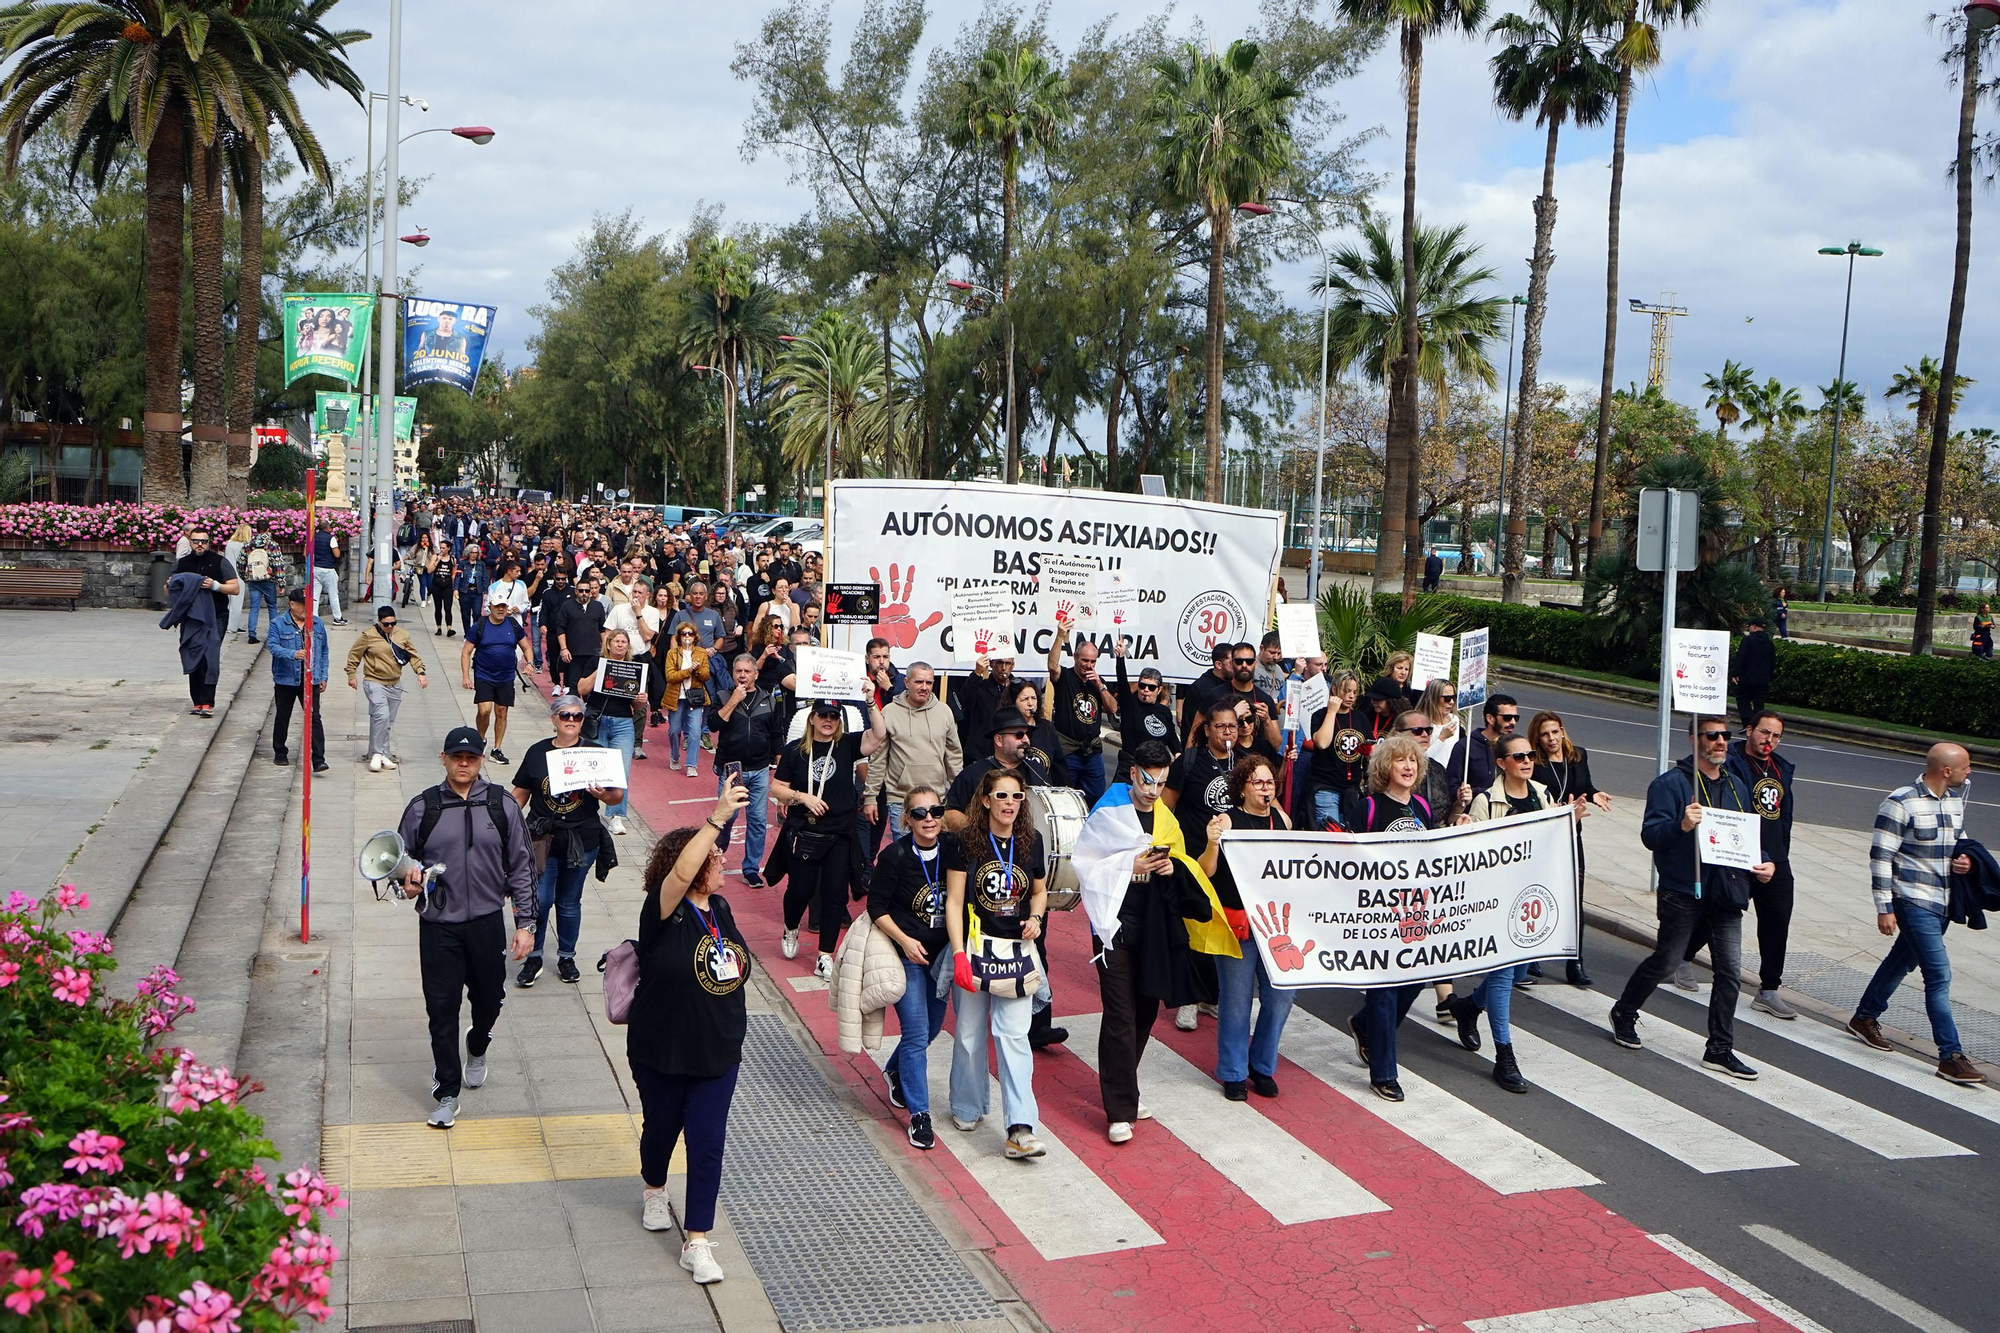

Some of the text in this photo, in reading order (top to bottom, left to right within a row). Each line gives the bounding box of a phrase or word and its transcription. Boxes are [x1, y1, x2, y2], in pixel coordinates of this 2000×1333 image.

[408, 299, 488, 328] LUCK RA
[311, 355, 356, 373] BECERRA
[413, 349, 470, 364] 20 JUNIO
[881, 504, 1218, 556] AUTÓNOMOS ASFIXIADOS!!
[1043, 557, 1097, 570] Si el Autónomo
[1048, 567, 1090, 578] Desaparece
[1050, 576, 1077, 586] España
[1049, 585, 1087, 596] Desvanece
[951, 610, 976, 618] Queremos
[964, 603, 989, 611] Queremos
[1225, 598, 1243, 630] NACIONAL
[1197, 609, 1228, 635] 30
[1184, 642, 1194, 653] DE
[1204, 635, 1217, 650] N
[1705, 665, 1717, 674] 30
[1700, 693, 1720, 701] pagar
[572, 748, 608, 756] autónomos
[1761, 787, 1778, 806] 30
[1261, 839, 1533, 881] AUTÓNOMOS ASFIXIADOS!!
[1357, 880, 1466, 909] BASTA YA!!
[1308, 898, 1499, 924] “PLATAFORMA POR LA DIGNIDAD
[1520, 899, 1542, 922] 30
[1342, 918, 1472, 940] DE LOS AUTÓNOMOS”
[1526, 920, 1536, 934] N
[1317, 935, 1498, 972] GRAN CANARIA
[981, 961, 1024, 975] TOMMY
